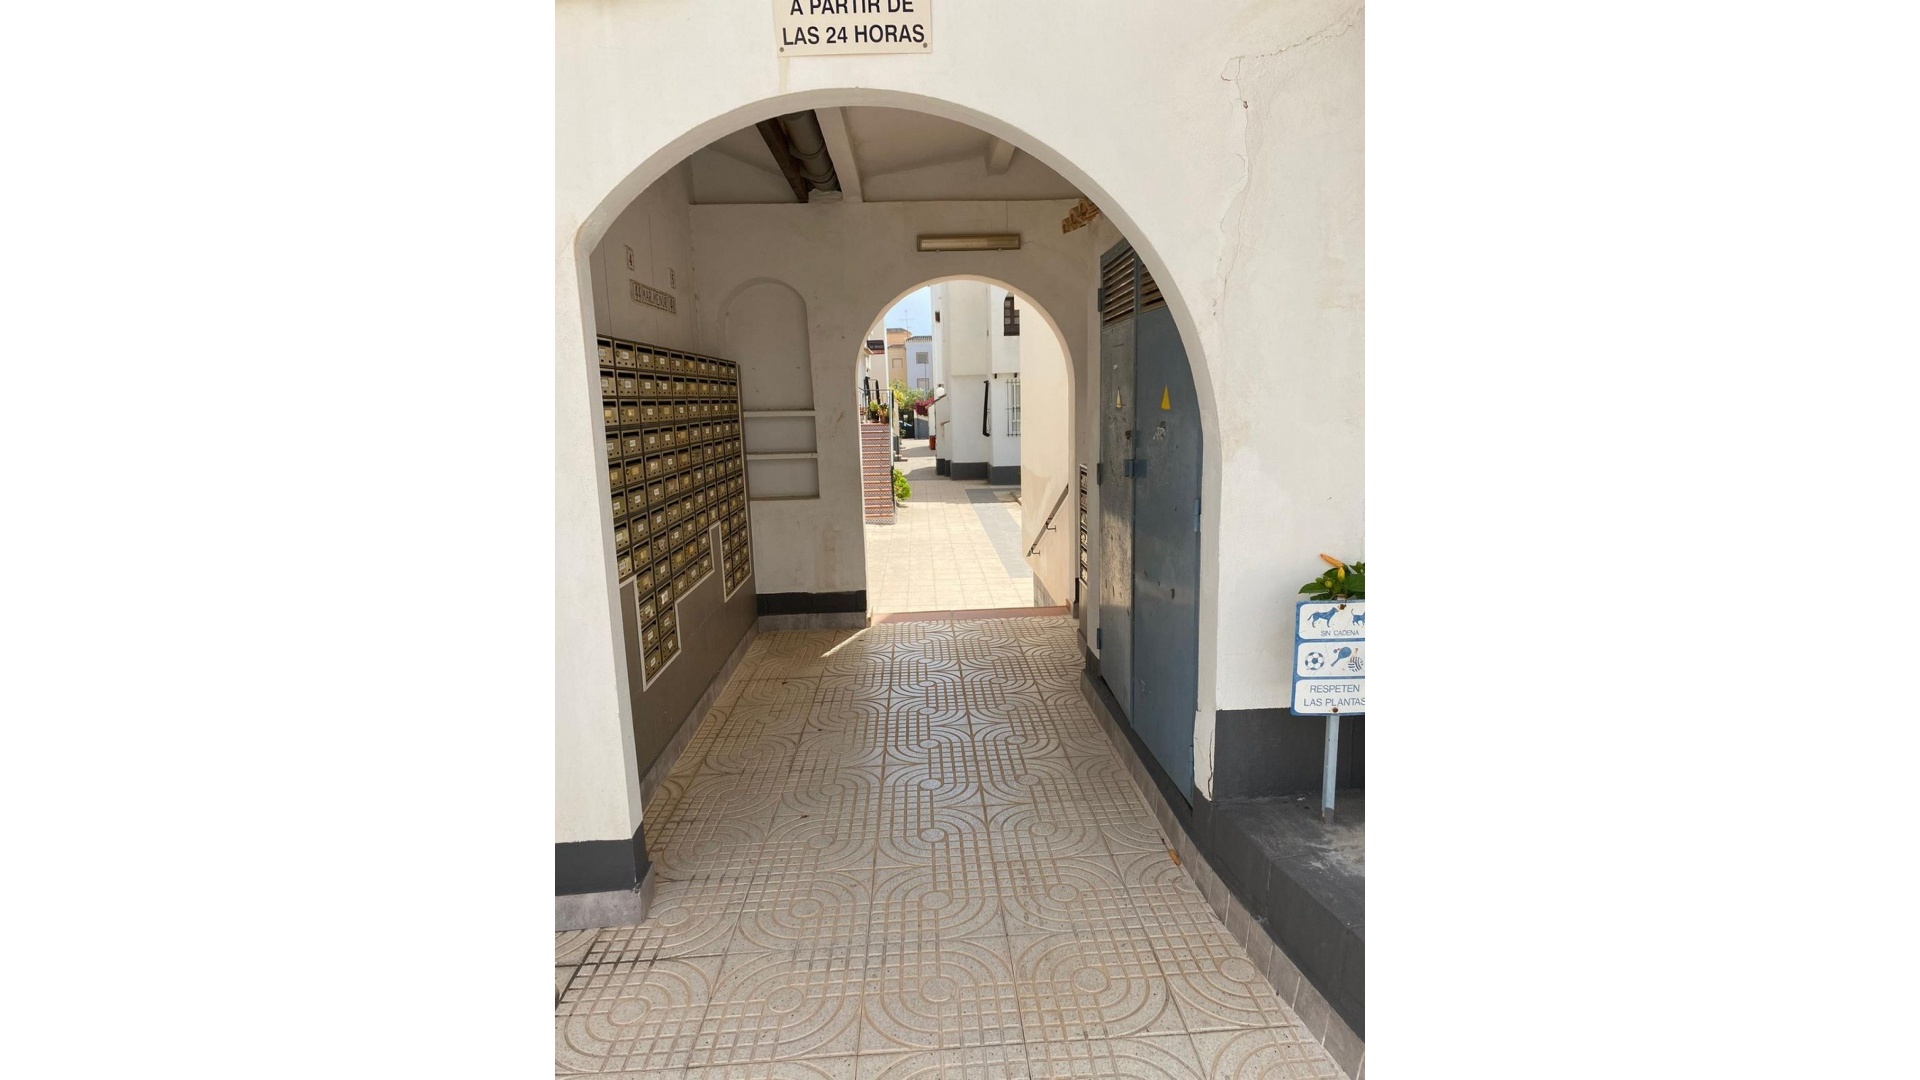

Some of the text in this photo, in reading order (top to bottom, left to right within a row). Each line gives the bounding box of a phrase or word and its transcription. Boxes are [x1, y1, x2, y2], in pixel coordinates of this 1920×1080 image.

[790, 0, 914, 15] A PARTIR DE
[782, 24, 925, 45] LAS 24 HORAS
[1309, 684, 1360, 693] RESPETEN
[1303, 698, 1323, 707] LAS
